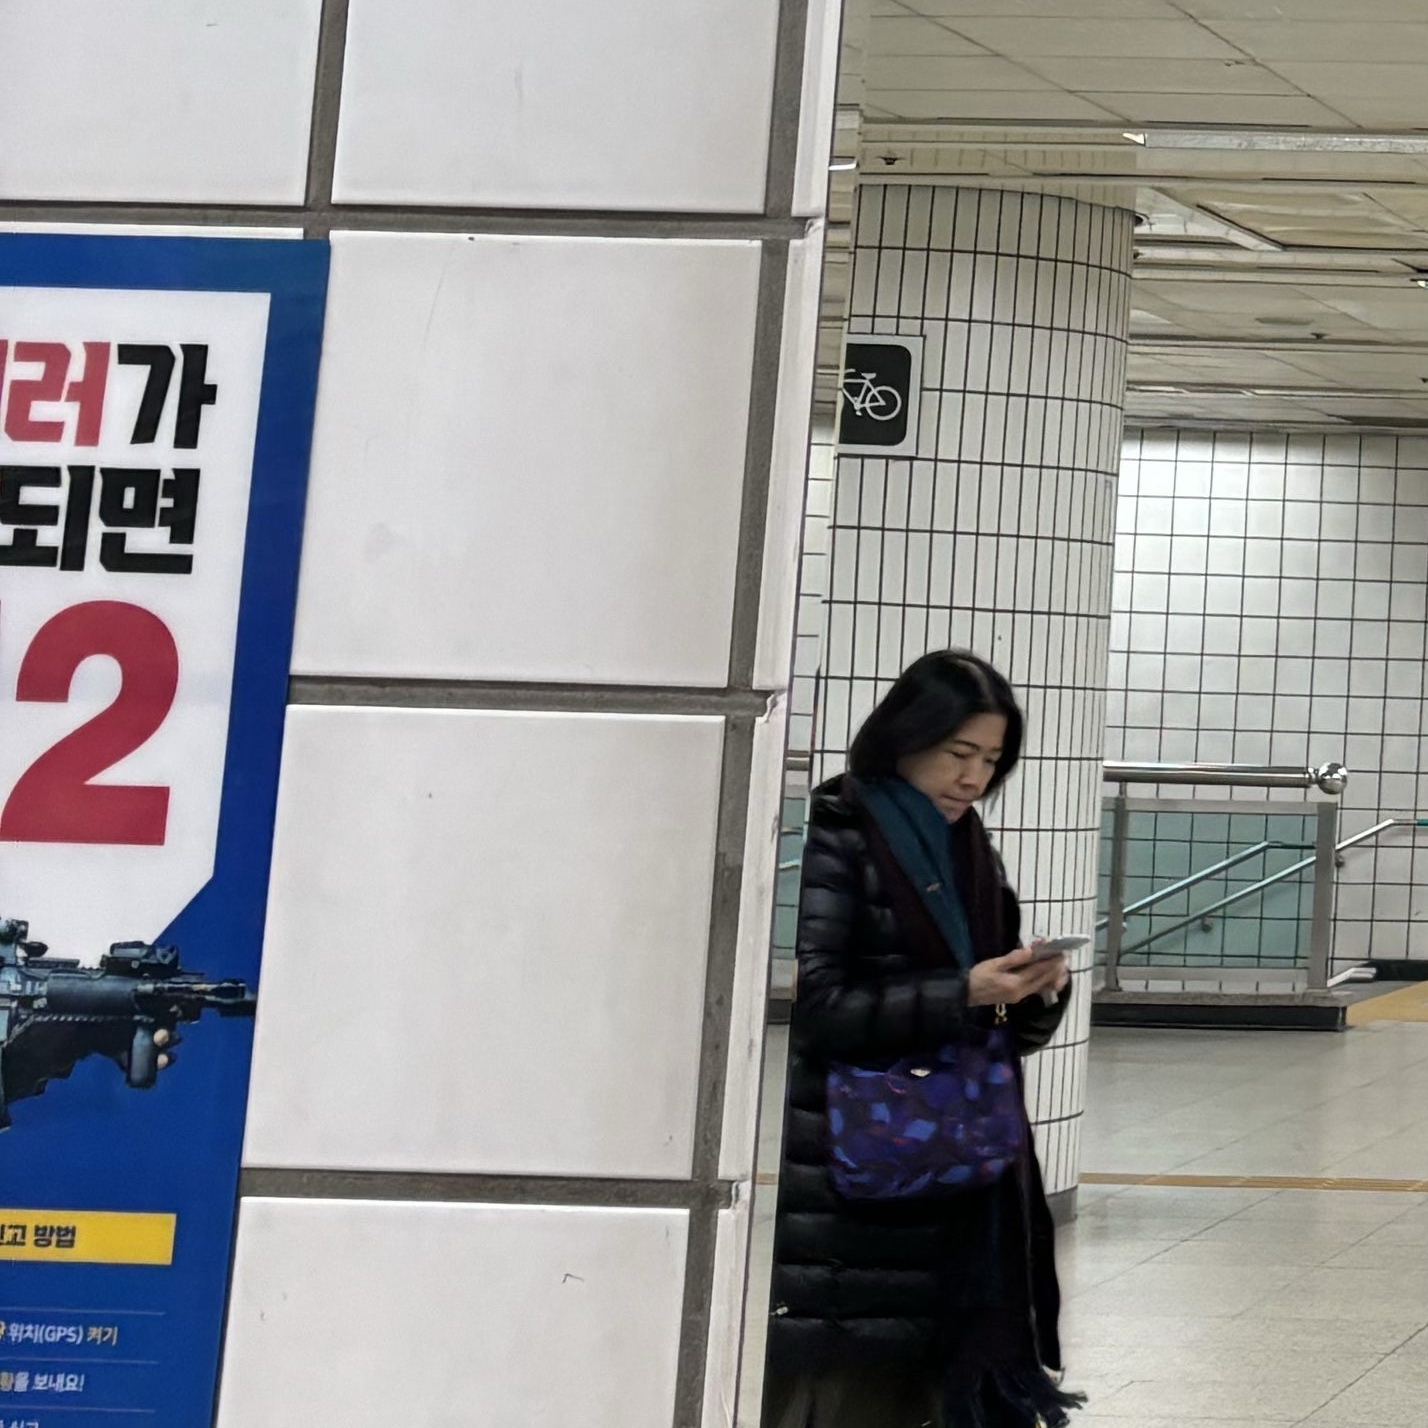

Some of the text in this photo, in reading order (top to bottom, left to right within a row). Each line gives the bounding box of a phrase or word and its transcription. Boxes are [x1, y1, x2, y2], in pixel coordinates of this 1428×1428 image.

[0, 339, 218, 450] 러가
[33, 1224, 77, 1249] 방법
[9, 1322, 84, 1345] 위치(GPS)
[32, 1373, 85, 1393] 보내요!
